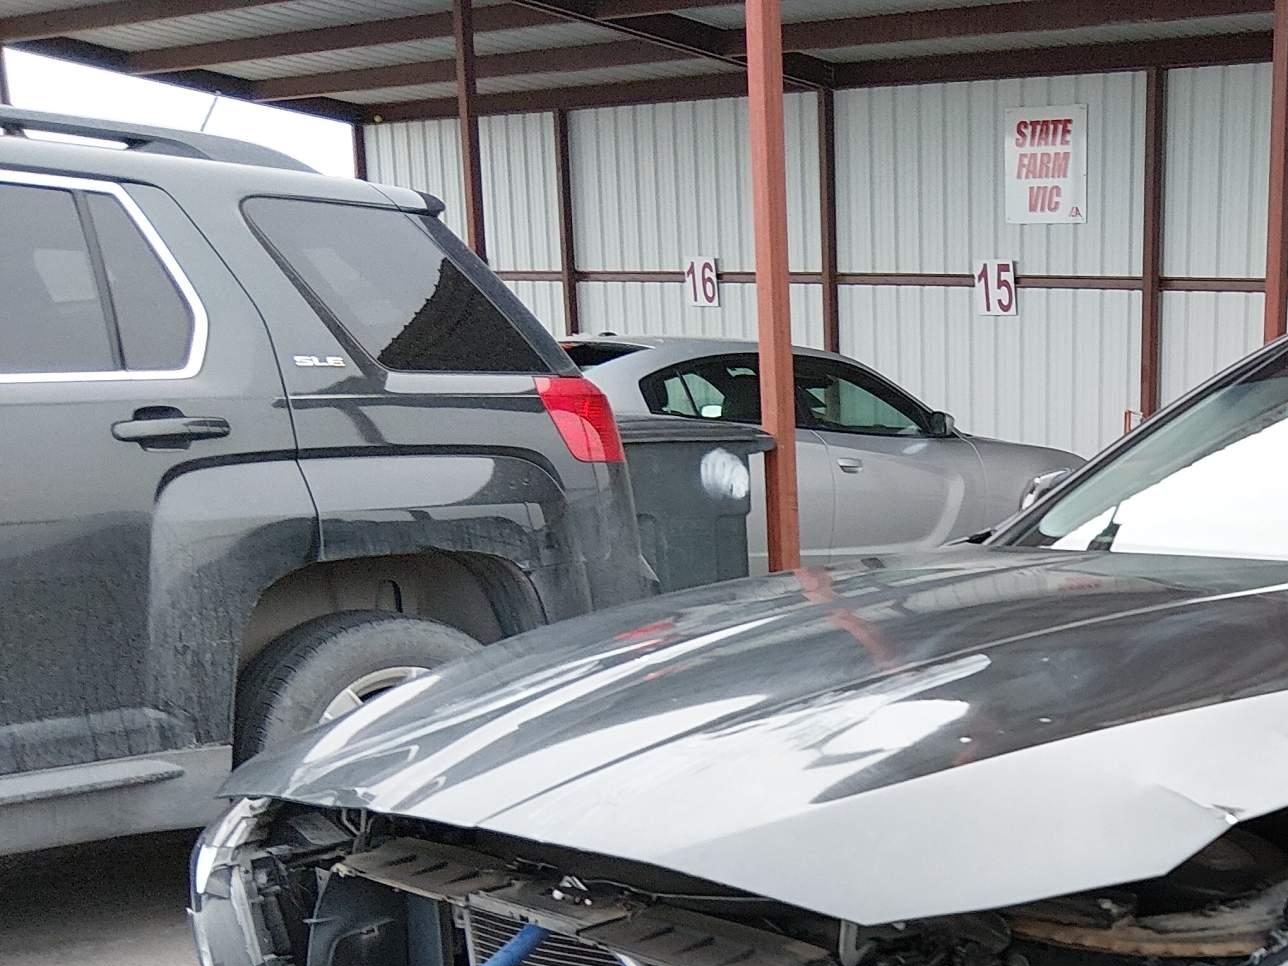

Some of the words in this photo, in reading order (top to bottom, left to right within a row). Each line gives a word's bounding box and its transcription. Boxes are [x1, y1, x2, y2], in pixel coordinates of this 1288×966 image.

[1015, 118, 1073, 147] STATE
[1016, 152, 1071, 179] FARM
[1028, 185, 1062, 212] VIC
[687, 261, 716, 303] 16
[977, 263, 1013, 312] 15
[293, 355, 346, 367] SLE
